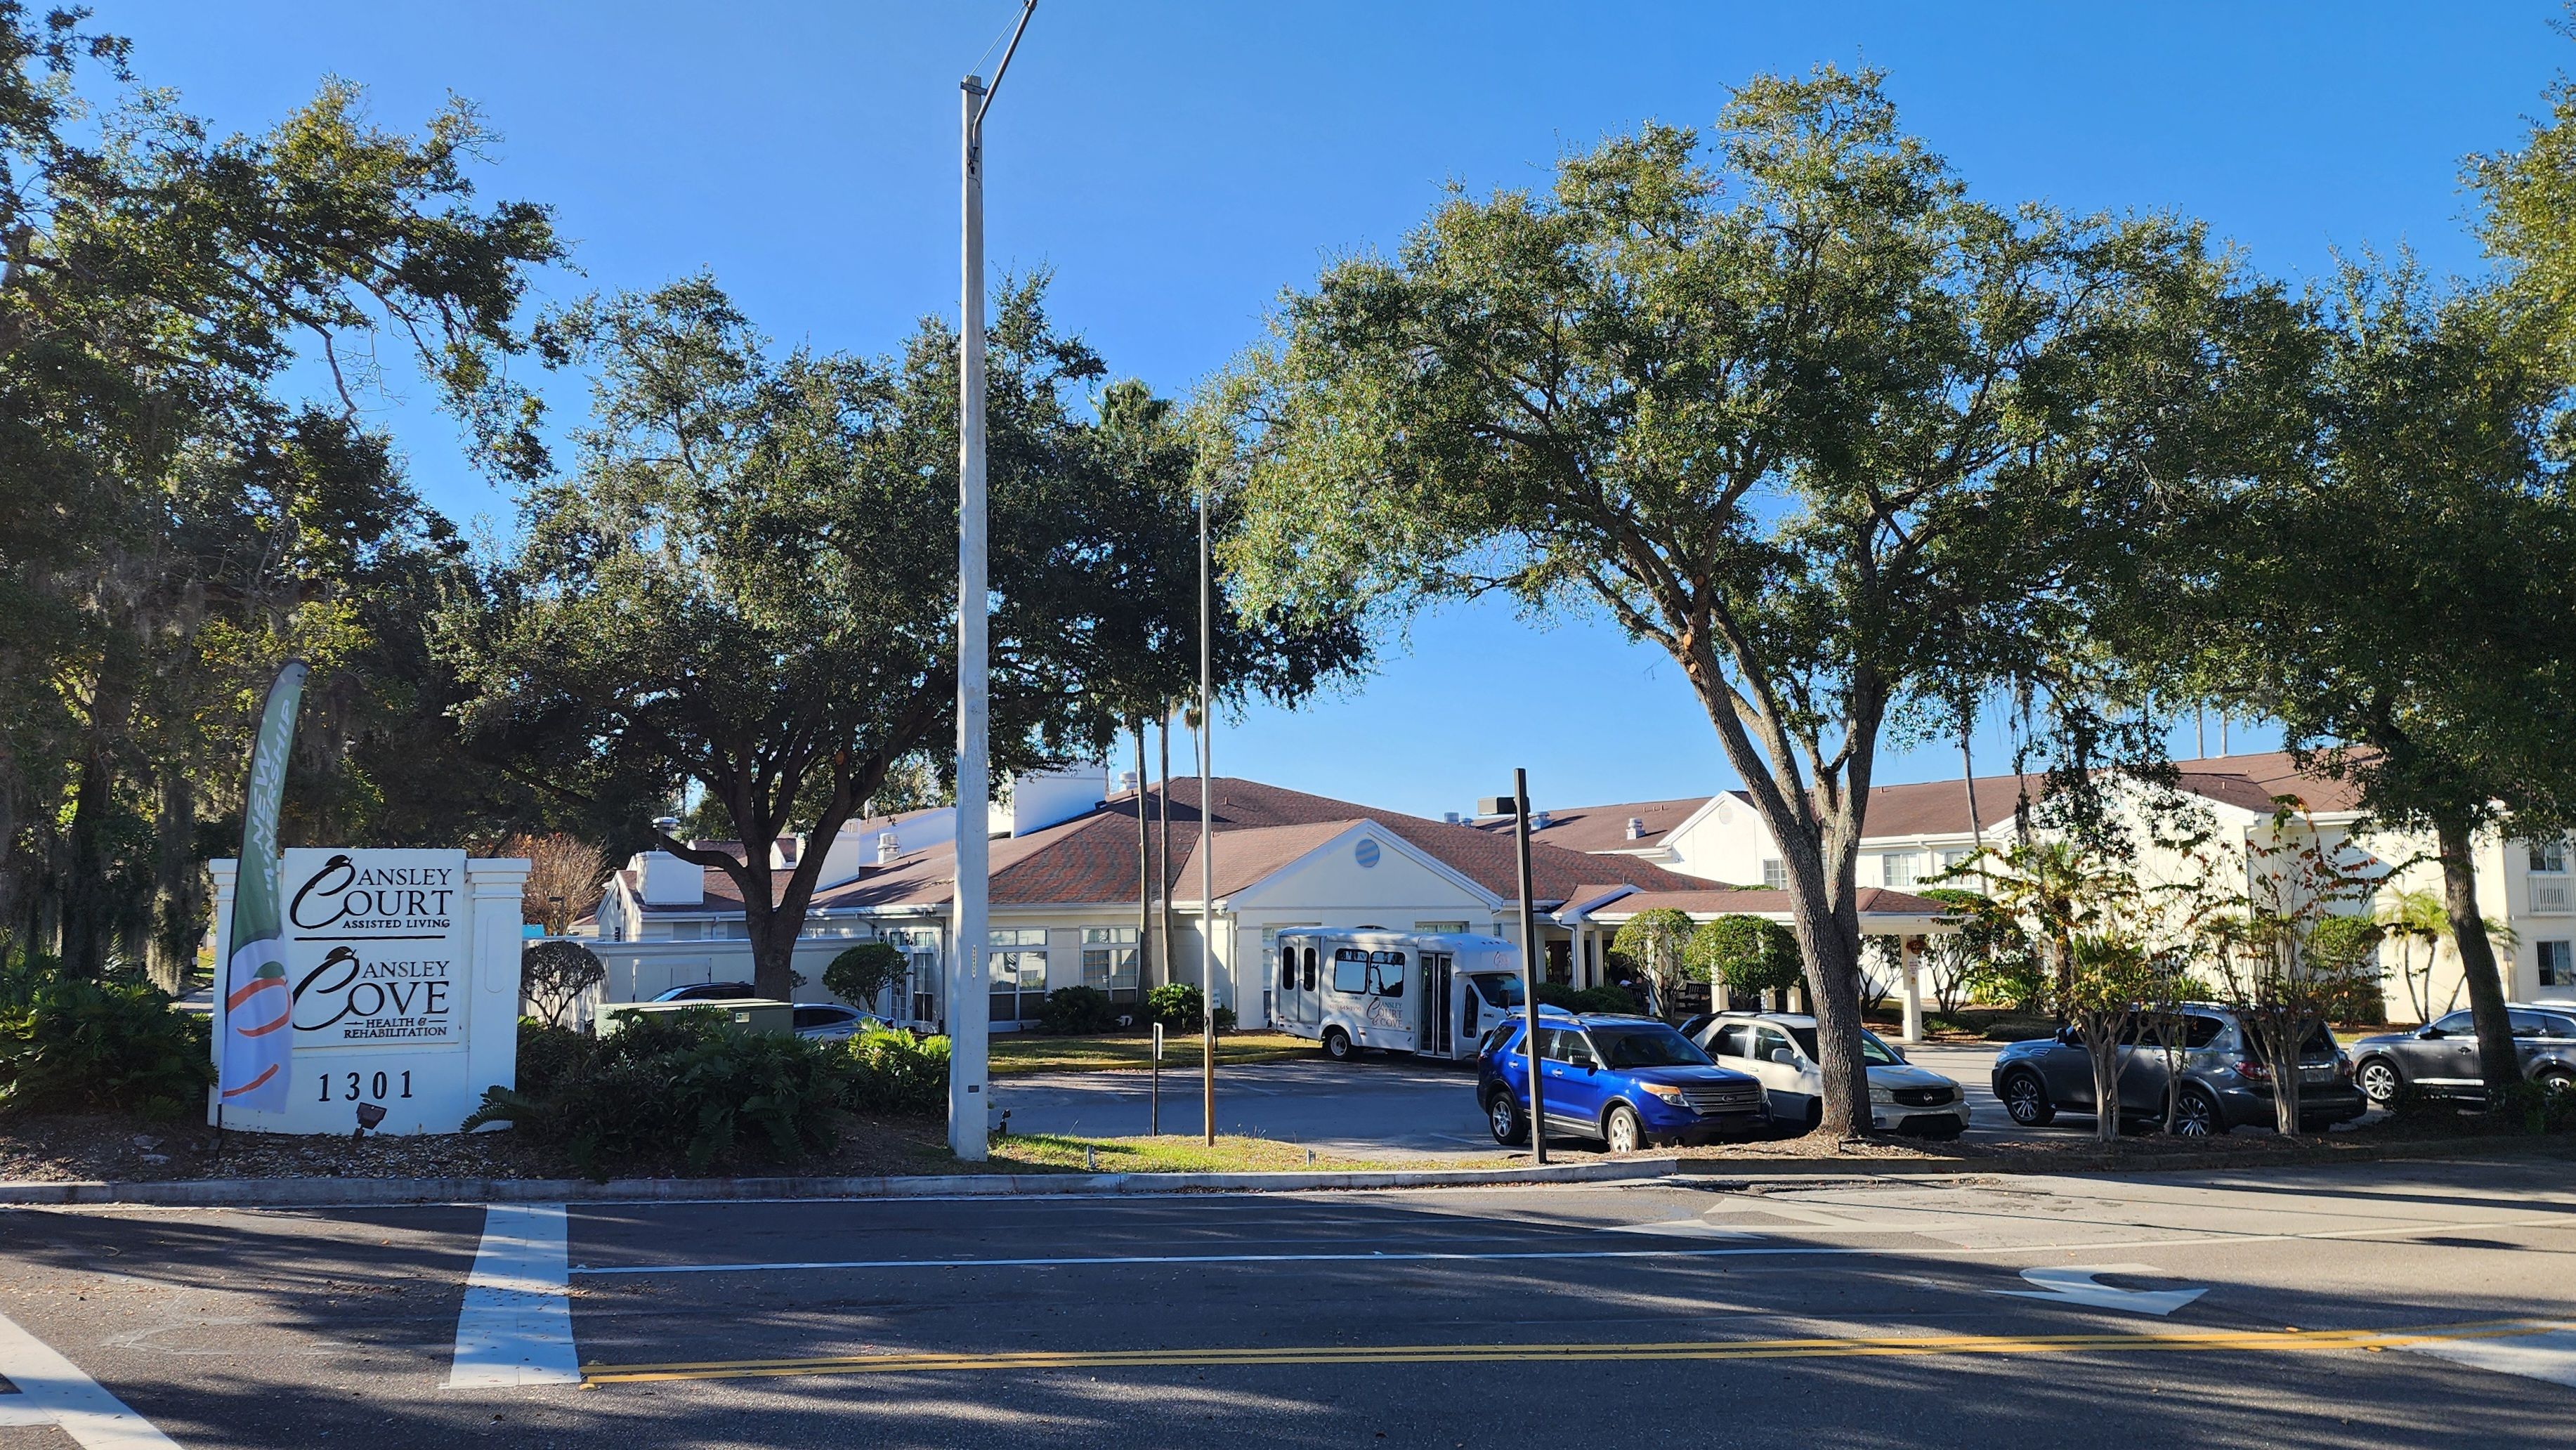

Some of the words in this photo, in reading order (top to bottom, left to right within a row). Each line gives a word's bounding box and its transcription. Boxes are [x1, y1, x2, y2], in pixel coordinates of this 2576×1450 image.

[252, 740, 272, 851] NEW
[356, 868, 452, 886] ANSLEY
[289, 861, 454, 929] COURT
[342, 919, 402, 929] ASSISTED
[406, 918, 451, 928] LIVING
[361, 960, 450, 979] ANSLEY
[292, 955, 450, 1031] COVE
[1366, 1000, 1403, 1020] COURT
[366, 1017, 415, 1028] HEALTH
[417, 1017, 427, 1026] &
[1380, 1018, 1403, 1028] COVE
[344, 1026, 447, 1039] REHABILITATION
[318, 1070, 413, 1102] 1301
